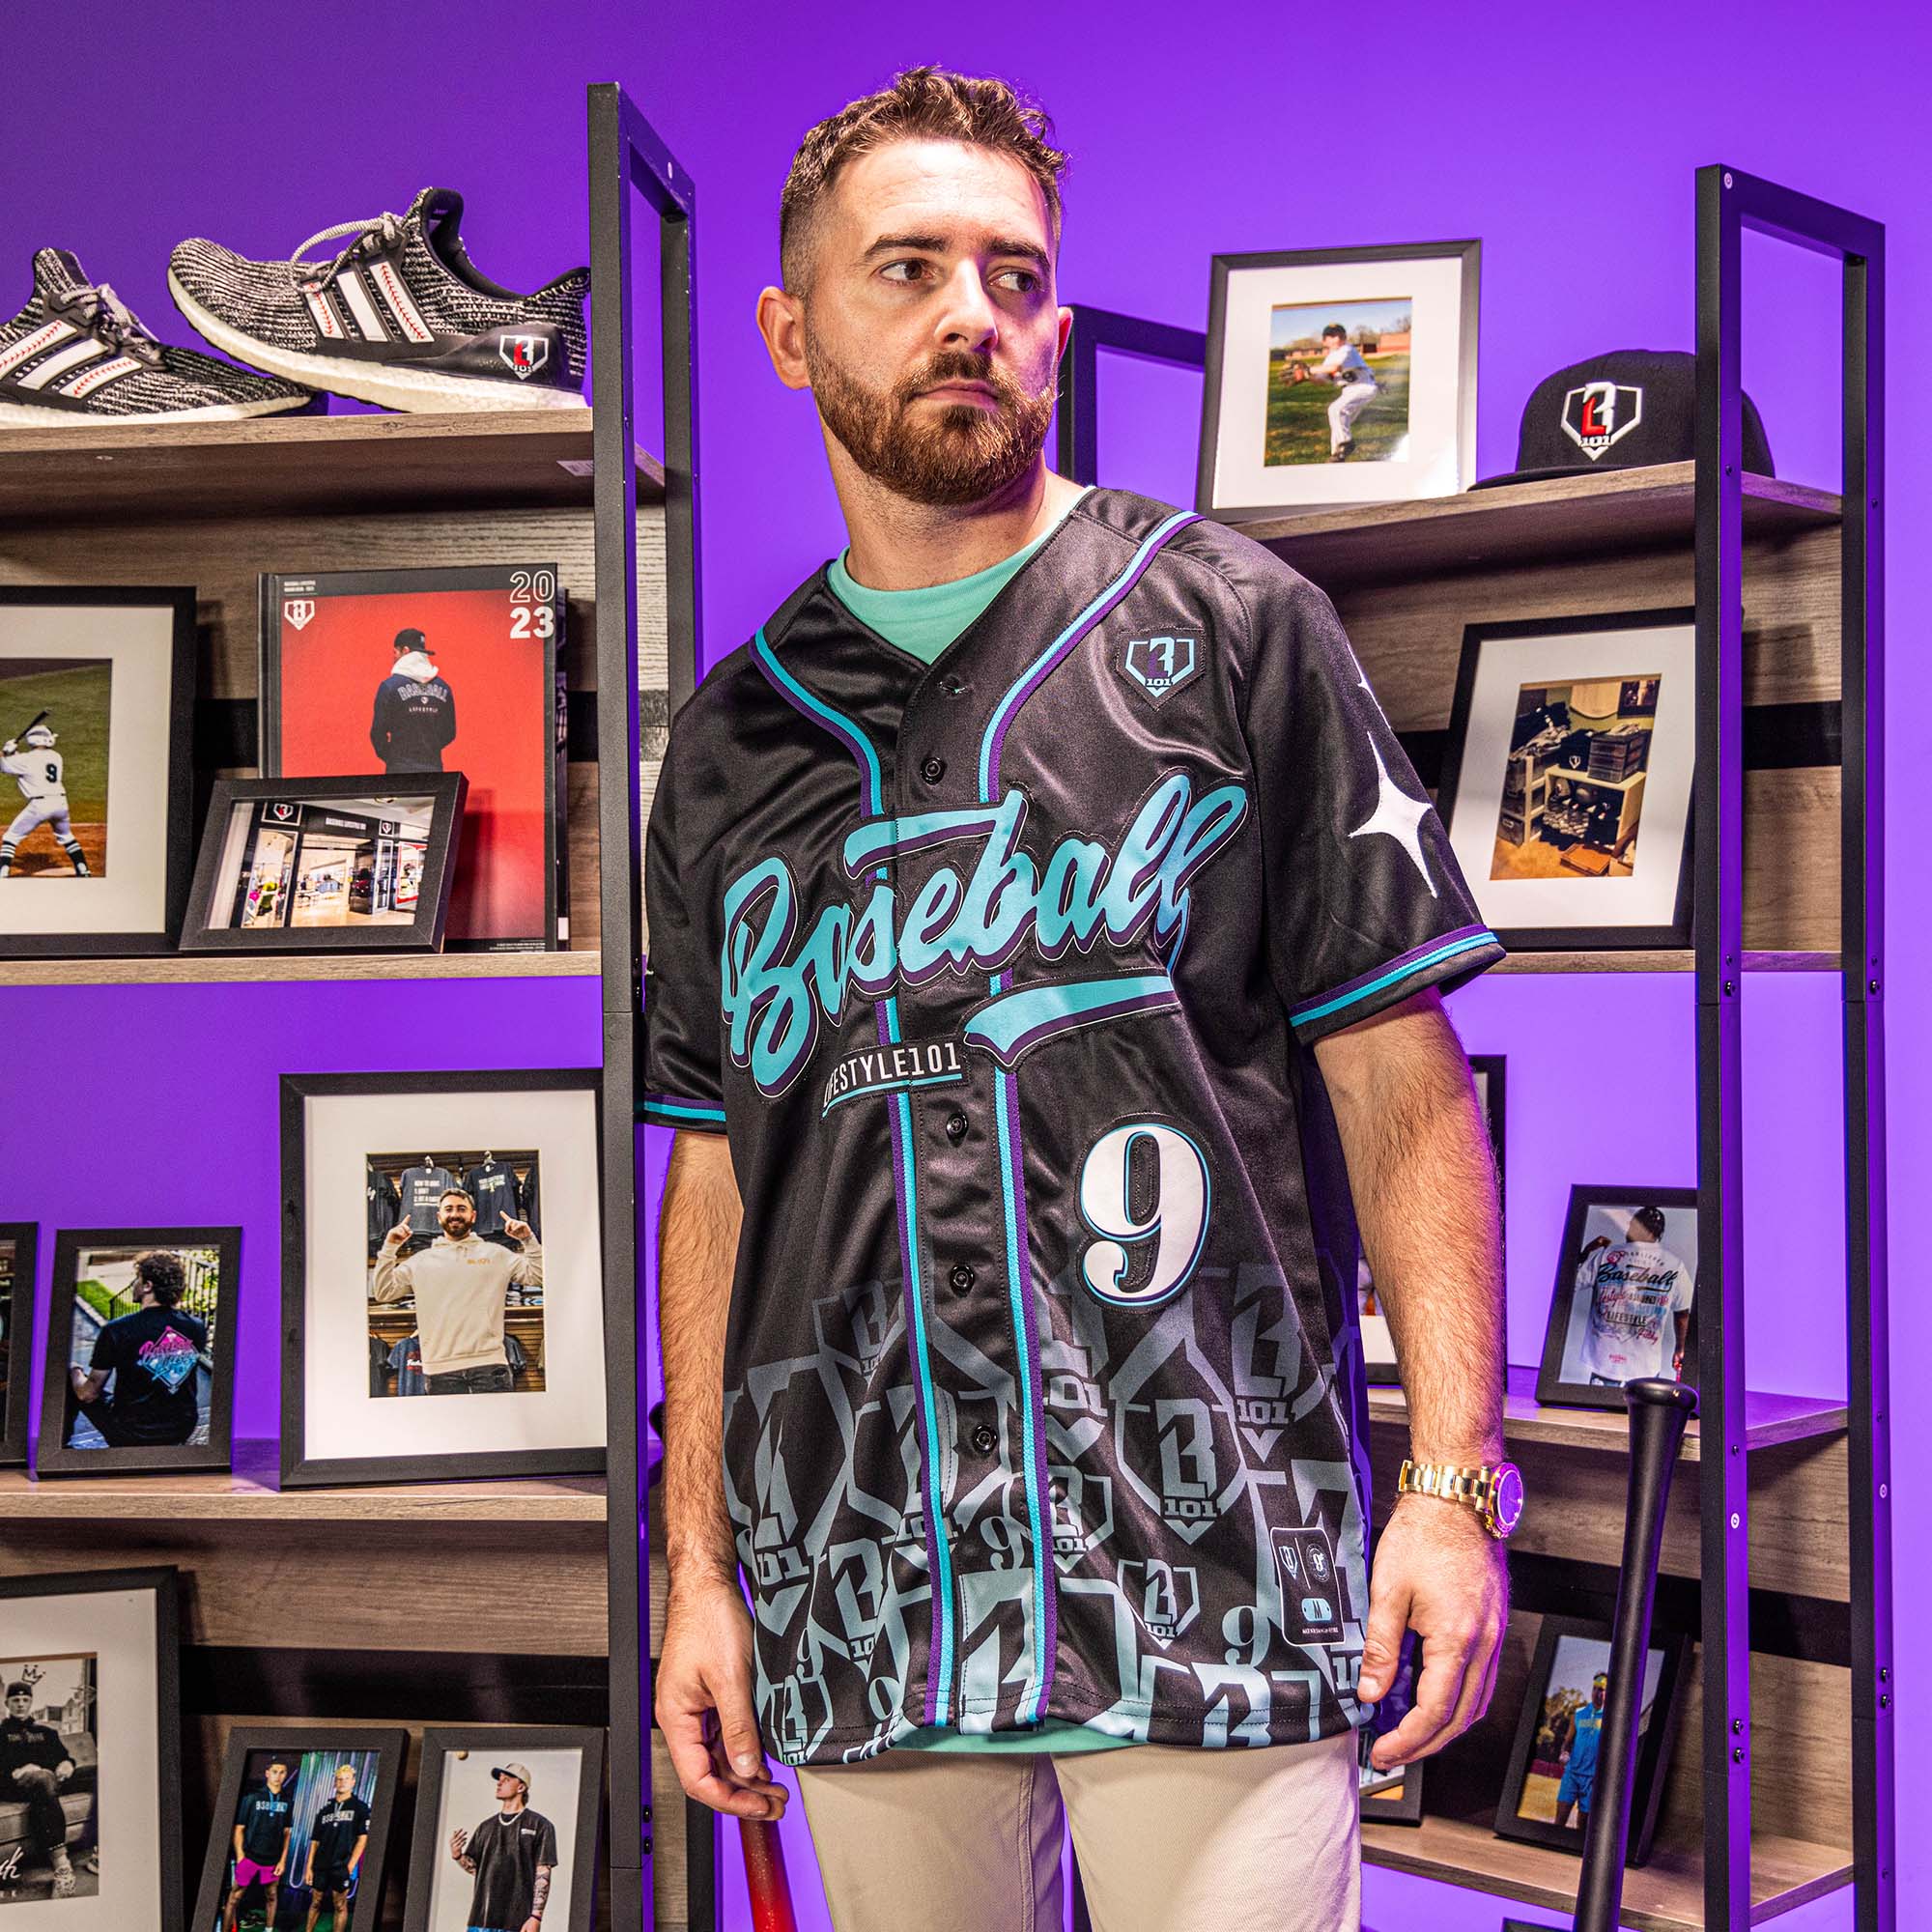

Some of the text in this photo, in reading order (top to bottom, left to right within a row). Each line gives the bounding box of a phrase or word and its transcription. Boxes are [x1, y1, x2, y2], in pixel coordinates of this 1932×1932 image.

[1580, 435, 1610, 446] 101
[509, 570, 555, 604] 20
[509, 606, 554, 639] 23
[1146, 678, 1172, 687] 101
[45, 763, 58, 783] 9
[722, 775, 1251, 1097] Baseball
[1080, 1122, 1211, 1307] 9
[1597, 1261, 1679, 1293] Baseball
[1043, 1375, 1109, 1417] 01
[1236, 1400, 1290, 1425] 101
[1164, 1500, 1218, 1519] 101
[980, 1516, 1024, 1570] 9
[1053, 1538, 1088, 1552] 01
[1312, 1600, 1323, 1621] M
[851, 1637, 876, 1658] 10
[1222, 1605, 1270, 1670] 9
